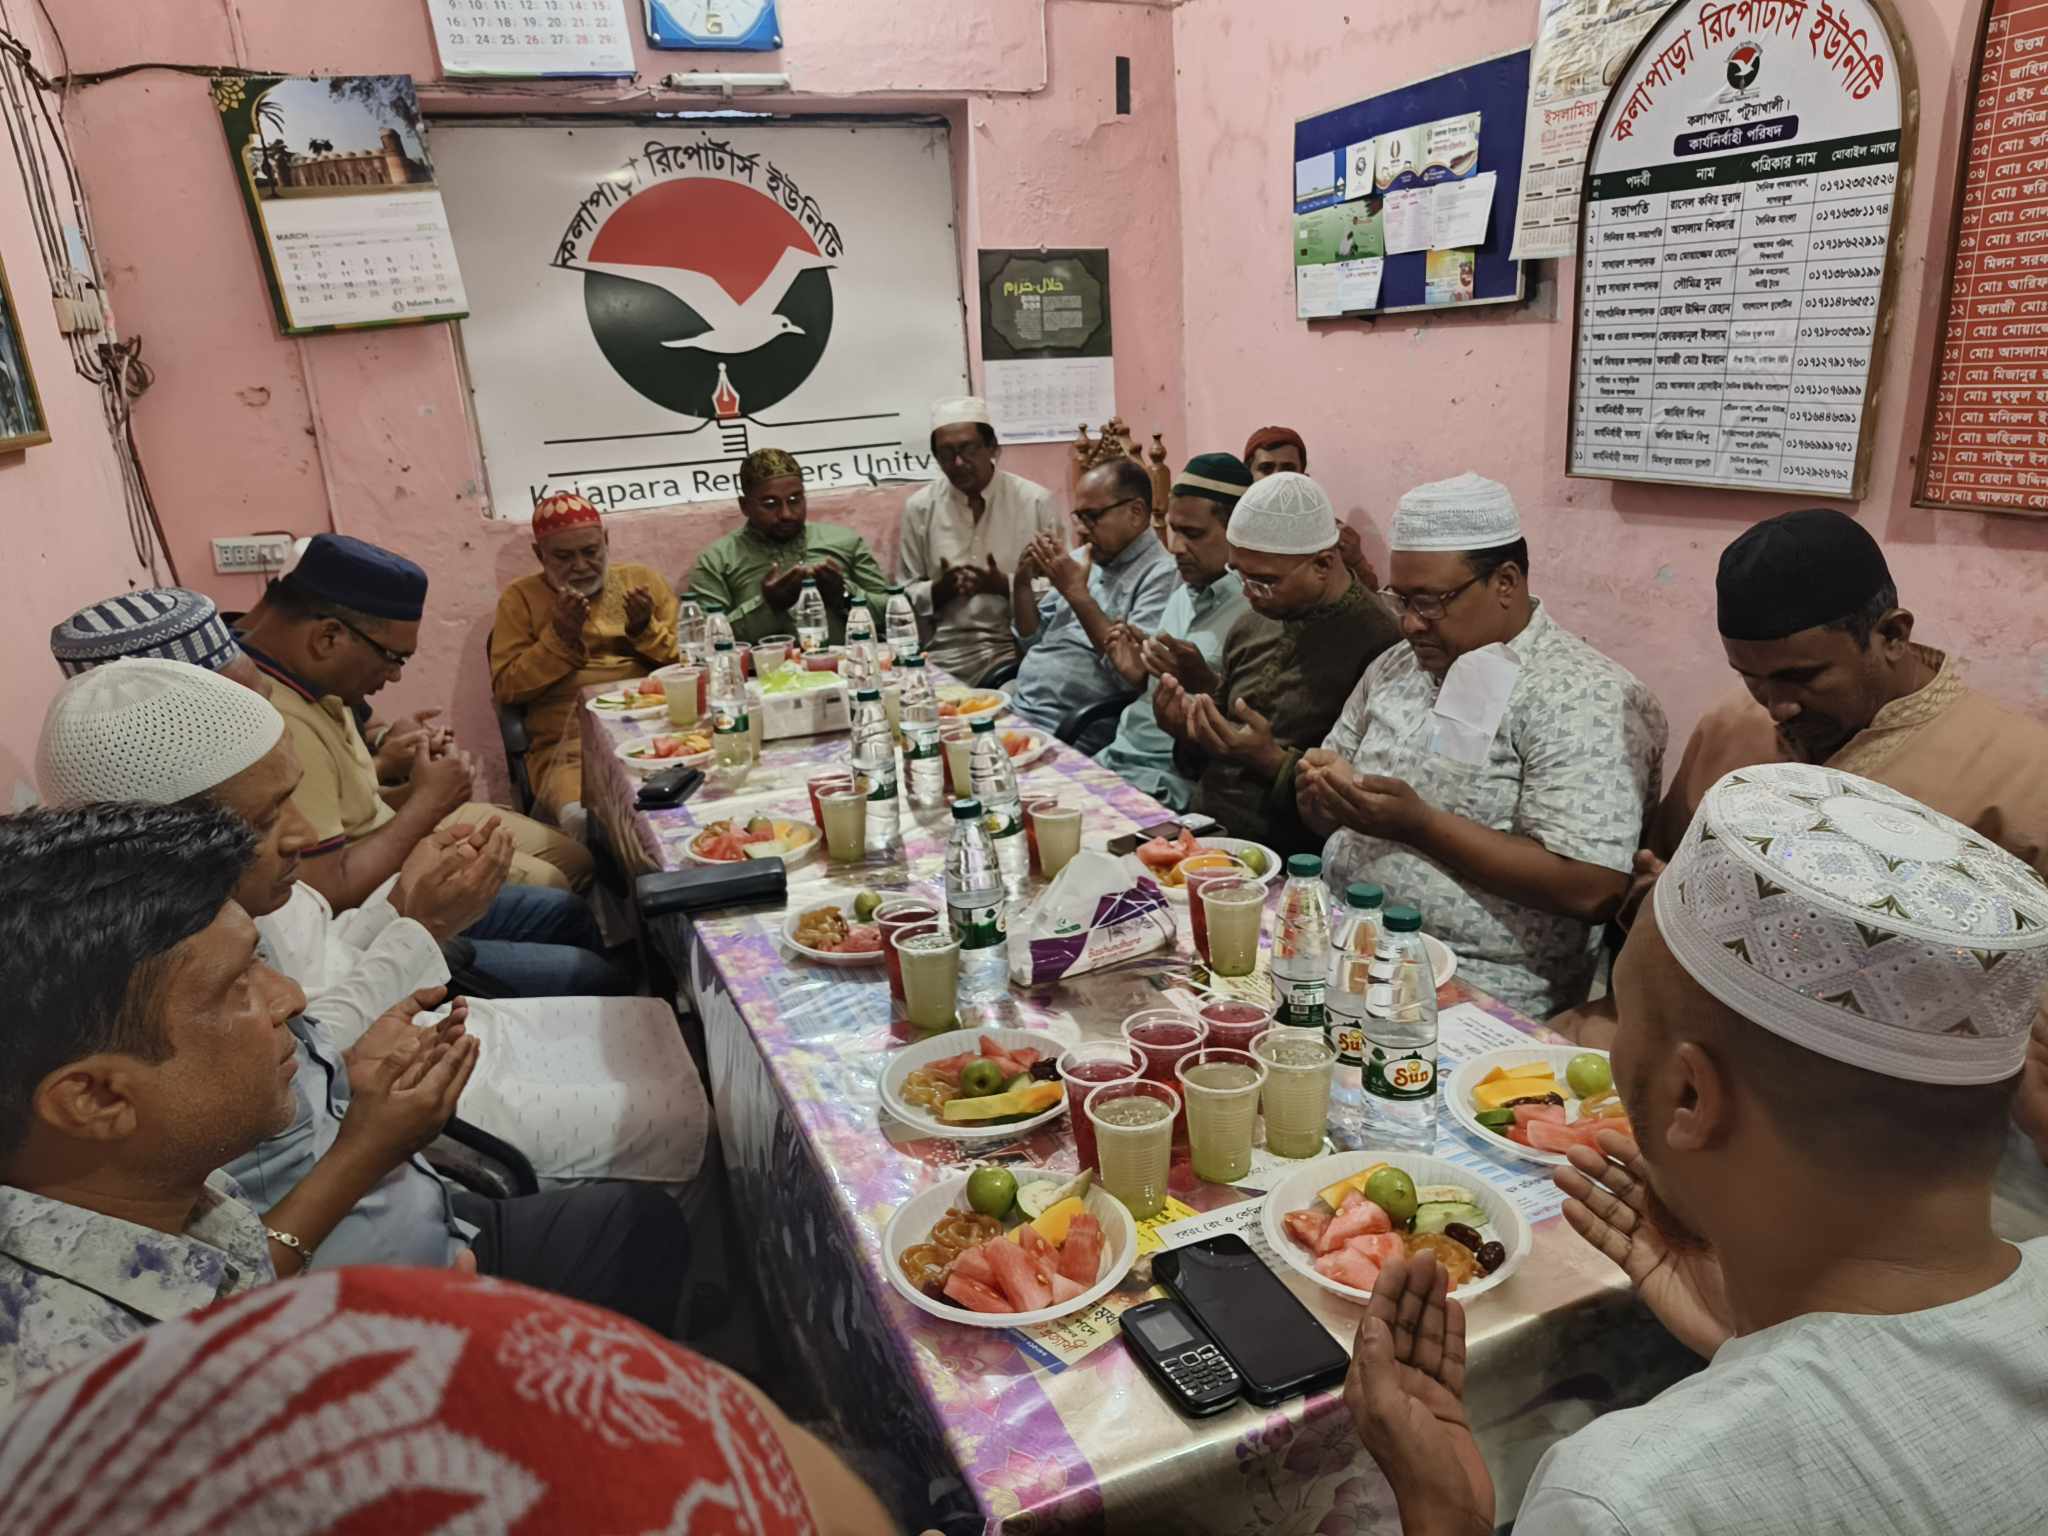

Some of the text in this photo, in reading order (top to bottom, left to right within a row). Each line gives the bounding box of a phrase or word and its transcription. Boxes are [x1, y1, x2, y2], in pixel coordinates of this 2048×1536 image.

[446, 17, 461, 27] 16
[472, 17, 485, 27] 17
[498, 17, 511, 28] 18
[523, 17, 537, 27] 19
[547, 17, 562, 28] 20
[595, 17, 608, 28] 22
[449, 34, 464, 45] 23
[475, 34, 490, 45] 24
[500, 34, 516, 45] 25
[525, 34, 539, 45] 26
[550, 34, 564, 44] 27
[1610, 29, 1696, 142] কলাপাড়া
[1809, 0, 1885, 100] ইউনিটি
[1981, 70, 1998, 83] ০২
[1978, 95, 1995, 108] ০৩
[1688, 124, 1783, 151] কার্যনির্বাহী পরিষদ
[1831, 144, 1868, 162] মোবাইল
[1998, 138, 2025, 154] মোঃ
[1751, 151, 1818, 173] পত্রিকার নাম
[1696, 165, 1717, 181] নাম
[1995, 162, 2022, 177] মোঃ
[1625, 173, 1652, 189] পদবী
[1991, 187, 2018, 200] মোঃ
[553, 137, 844, 266] কলাপাড়া রিপোর্টার্স ইউনিটি
[1611, 199, 1650, 218] সভাপতি
[1988, 210, 2016, 225] মোঃ
[276, 233, 309, 241] MARCH
[1985, 232, 2012, 248] মোঃ
[1957, 259, 1972, 270] ১০
[1703, 277, 1722, 291] সুমন
[1953, 282, 1968, 295] ১১
[1977, 279, 2003, 294] মোঃ
[1950, 303, 1964, 316] ১২
[2020, 299, 2048, 313] মোঃ
[1947, 324, 1998, 338] ১৩ মোঃ
[1969, 347, 1995, 360] মোঃ
[1966, 369, 1989, 381] মোঃ
[1963, 390, 1988, 402] মোঃ
[1960, 411, 1984, 424] মোঃ
[1958, 431, 1982, 444] মোঃ
[1955, 451, 1978, 464] মোঃ
[1952, 471, 1975, 484] মোঃ
[1950, 489, 1972, 502] মোঃ
[1338, 1032, 1362, 1052] Su
[1394, 1066, 1429, 1088] Sun
